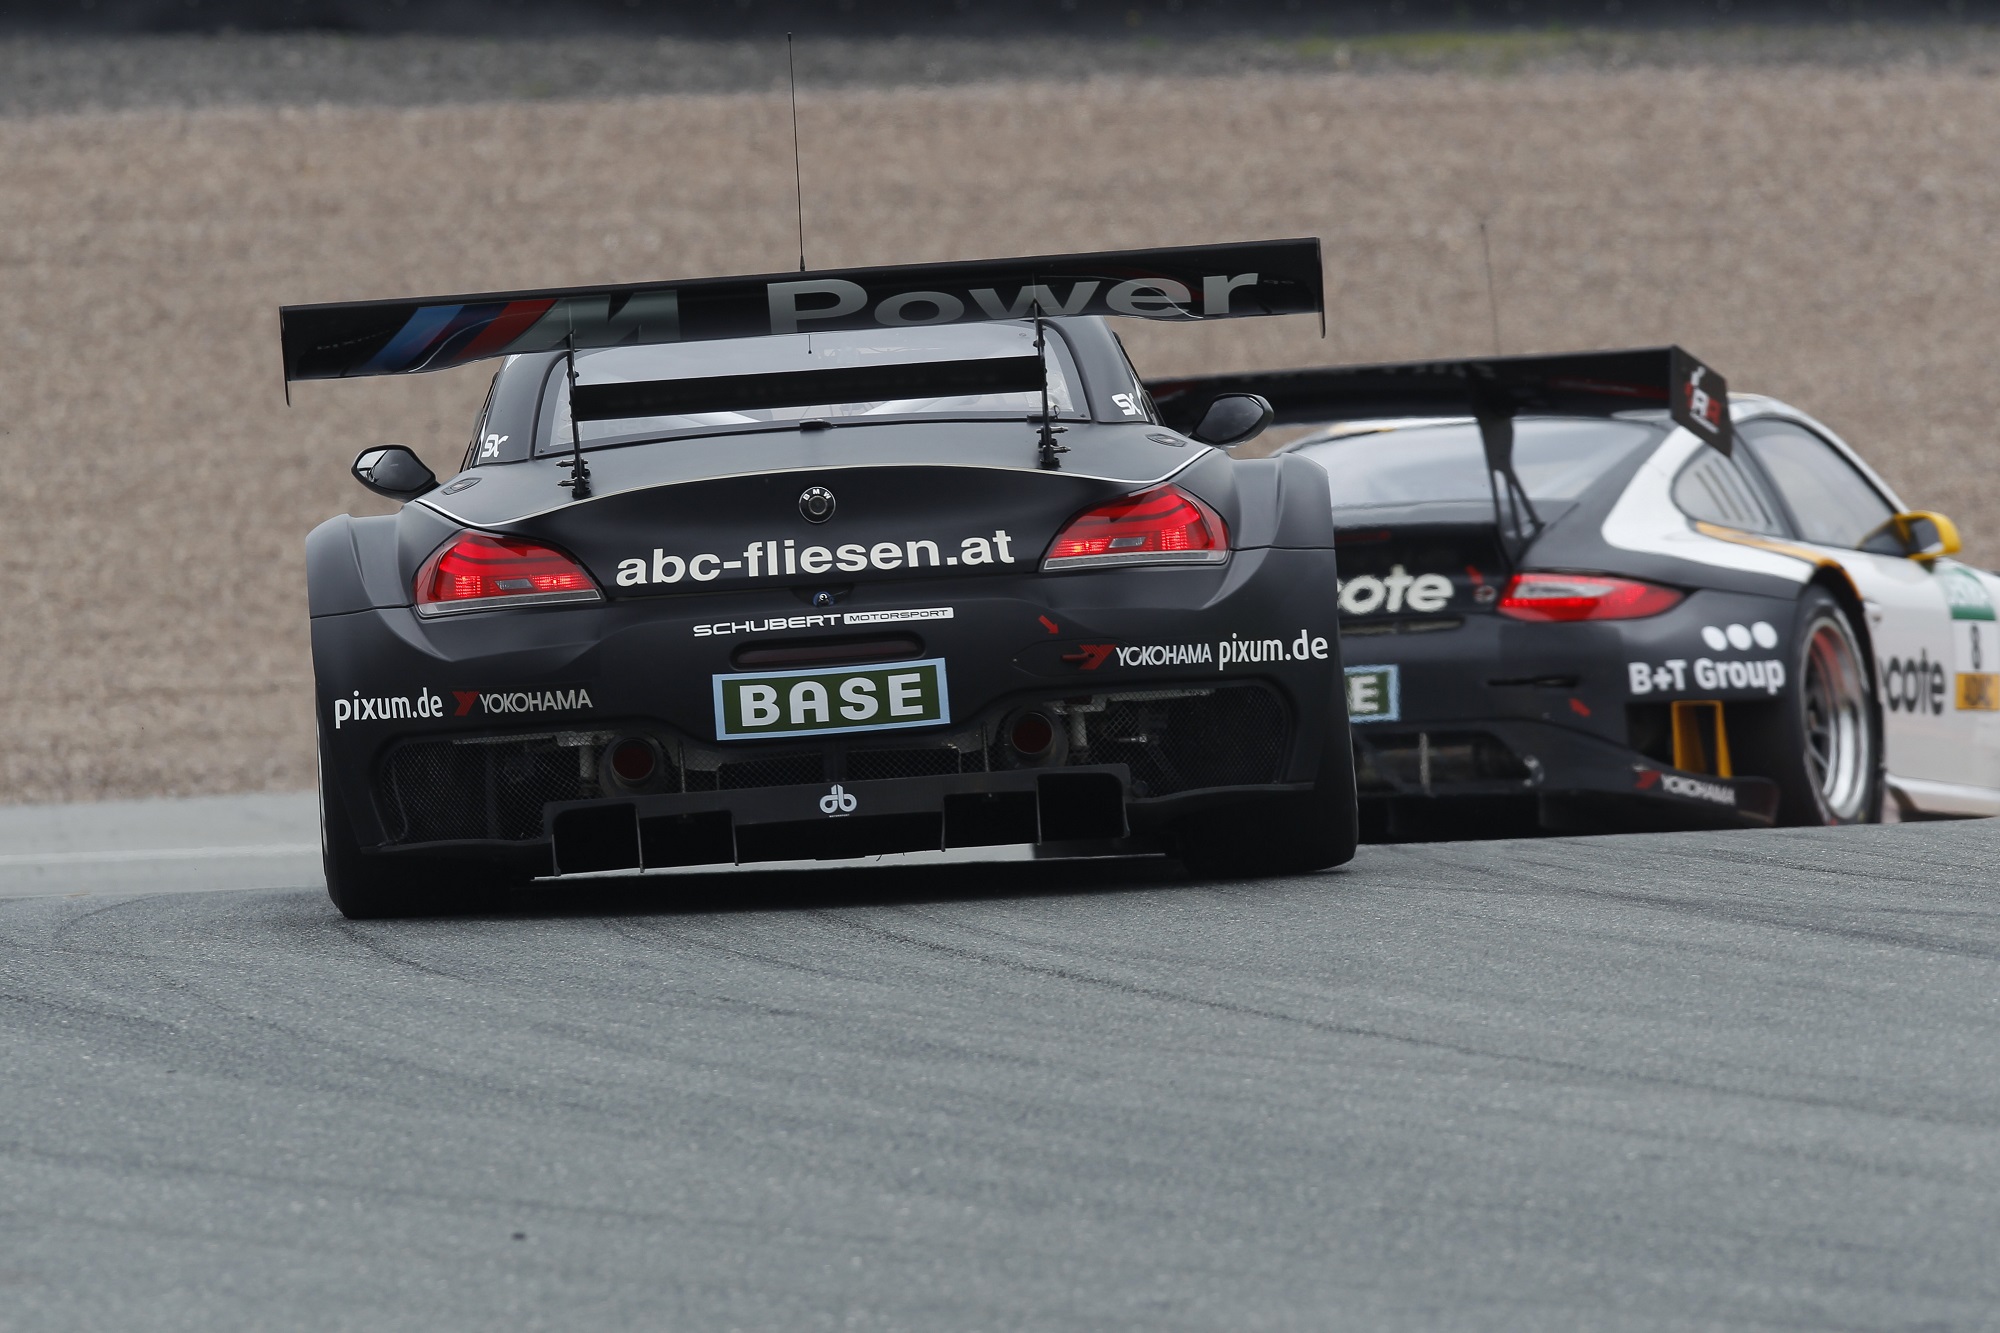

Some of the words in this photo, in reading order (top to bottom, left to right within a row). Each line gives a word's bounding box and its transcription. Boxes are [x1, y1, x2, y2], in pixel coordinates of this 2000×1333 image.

[766, 271, 1259, 334] Power
[802, 488, 832, 501] BMW
[615, 529, 1015, 588] abc-fliesen.at
[1337, 564, 1455, 615] ote
[693, 613, 842, 637] SCHUBERT
[849, 609, 949, 622] MOTORSPORT
[1115, 643, 1213, 667] YOKOHAMA
[1218, 628, 1329, 671] pixum.de
[1628, 658, 1687, 694] B+T
[1694, 656, 1786, 695] Group
[1878, 646, 1946, 716] cote
[334, 686, 444, 729] pixum.de
[479, 688, 593, 714] YOKOHAMA
[738, 672, 925, 728] BASE
[1660, 773, 1736, 806] YOKOHAMA
